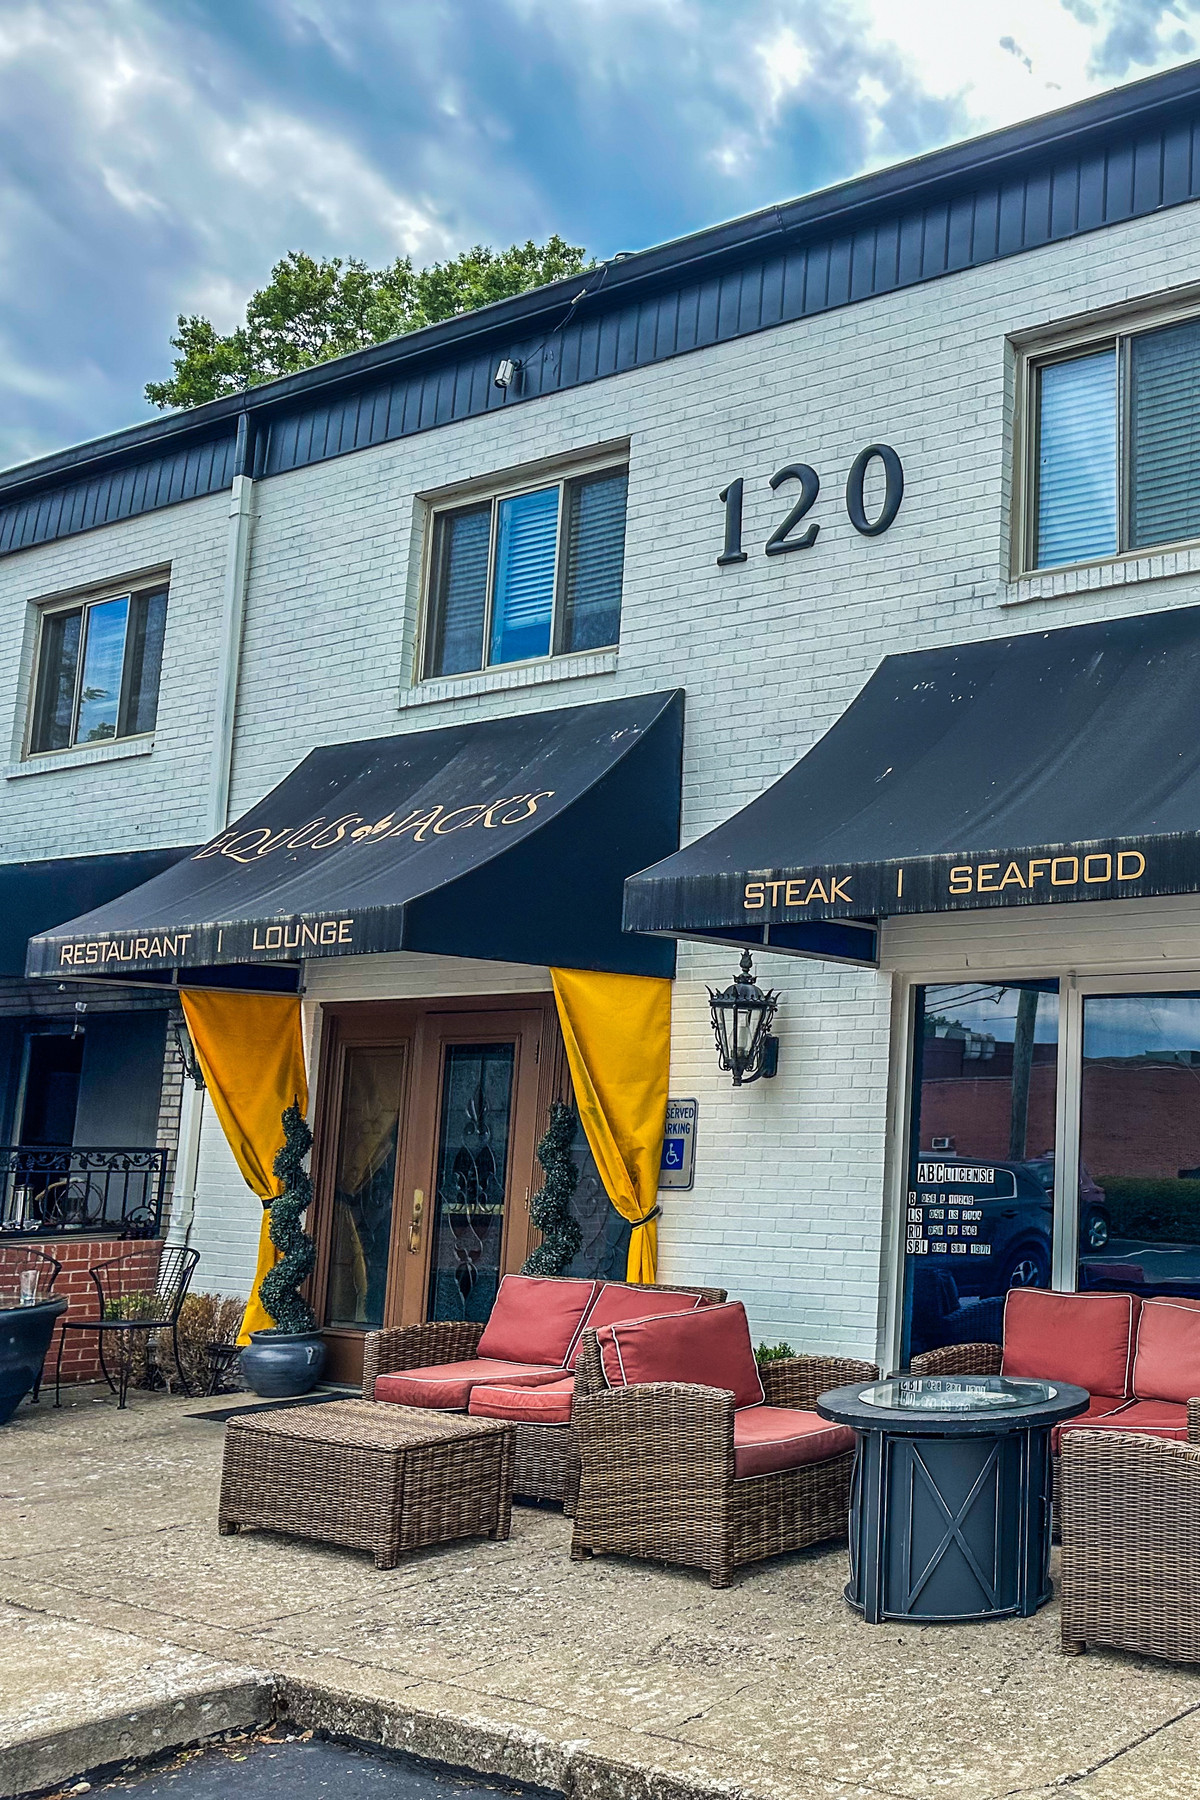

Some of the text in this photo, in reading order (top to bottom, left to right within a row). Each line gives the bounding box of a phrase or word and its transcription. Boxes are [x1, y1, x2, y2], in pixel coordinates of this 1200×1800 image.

[717, 443, 904, 566] 120
[190, 791, 555, 863] EQUUS JACK'S
[743, 876, 853, 909] STEAK
[948, 850, 1146, 895] SEAFOOD
[59, 933, 192, 965] RESTAURANT
[252, 919, 354, 950] LOUNGE
[666, 1107, 694, 1119] SERVED
[665, 1122, 690, 1134] RKING
[945, 1168, 994, 1183] LICENSE
[909, 1192, 916, 1205] B
[908, 1208, 922, 1222] LS
[907, 1240, 928, 1254] SBL
